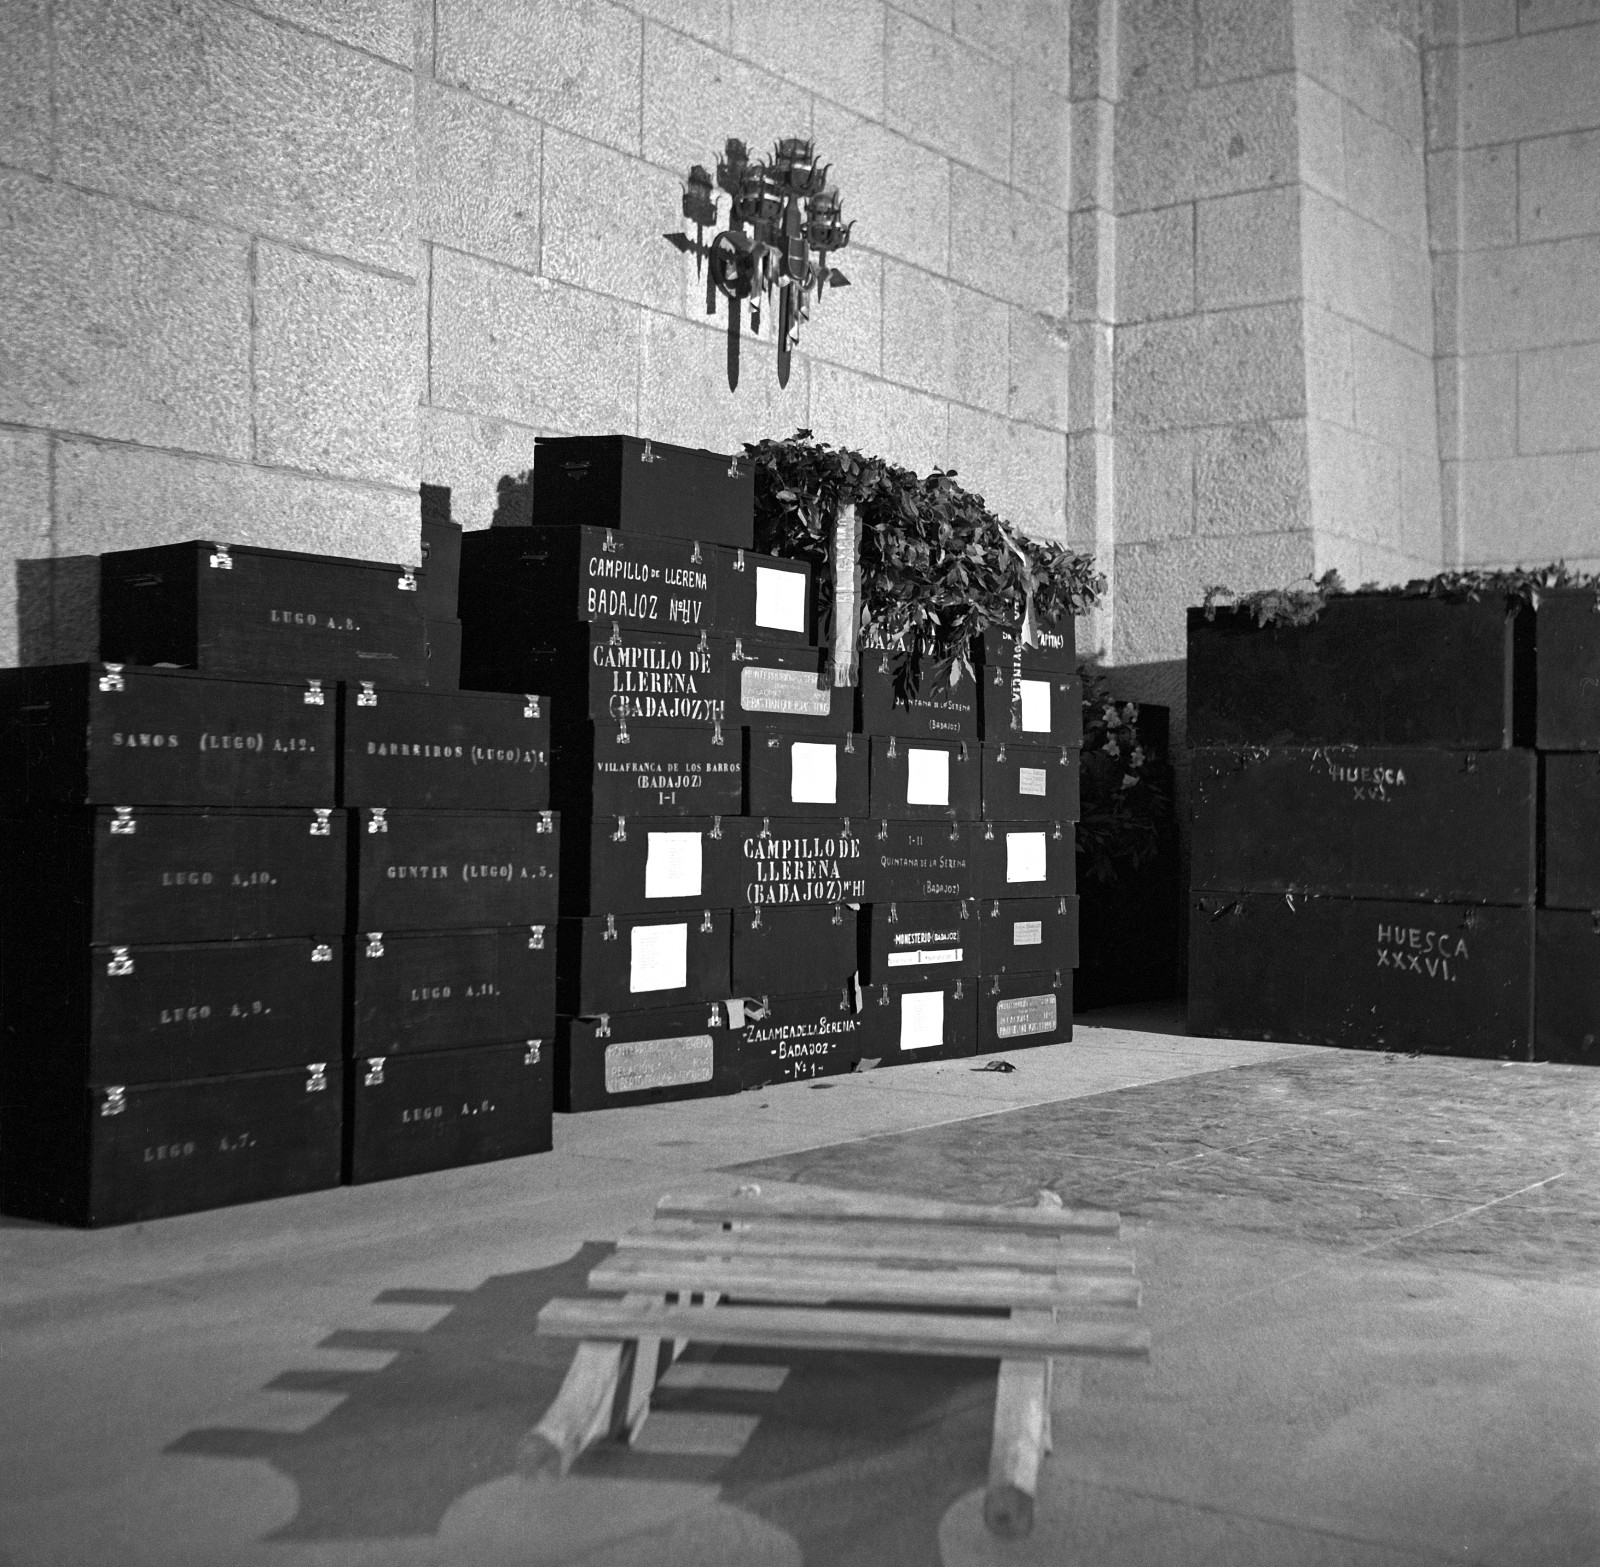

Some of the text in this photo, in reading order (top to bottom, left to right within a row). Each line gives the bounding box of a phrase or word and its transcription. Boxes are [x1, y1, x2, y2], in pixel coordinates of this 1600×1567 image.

[589, 557, 648, 582] CAMPILLO
[665, 568, 707, 590] LLERENA
[588, 587, 658, 620] BADAJOZ
[271, 610, 317, 626] LUGO
[593, 645, 711, 674] CAMPILLO DE
[613, 671, 697, 694] LLERENA
[1011, 645, 1022, 702] OVINCIA
[597, 762, 741, 773] VILLAFRANCA DE LOS BARROS
[1329, 764, 1406, 785] HUESCA
[637, 775, 702, 789] (BADAJOZ)
[743, 838, 860, 860] CAMPILLO DE
[387, 866, 449, 879] GUNTIN
[462, 863, 513, 882] (LUGO)
[756, 859, 841, 882] LLERENA
[880, 855, 918, 868] QUINTANA
[939, 855, 967, 869] SERENA
[746, 880, 842, 904] (BADAJOZ)
[922, 880, 960, 896] (BADAJOZ)
[1377, 923, 1470, 960] HUESCA
[1376, 948, 1457, 982] XXXVI.
[411, 985, 451, 1001] LUGO
[402, 1105, 443, 1124] LUGO
